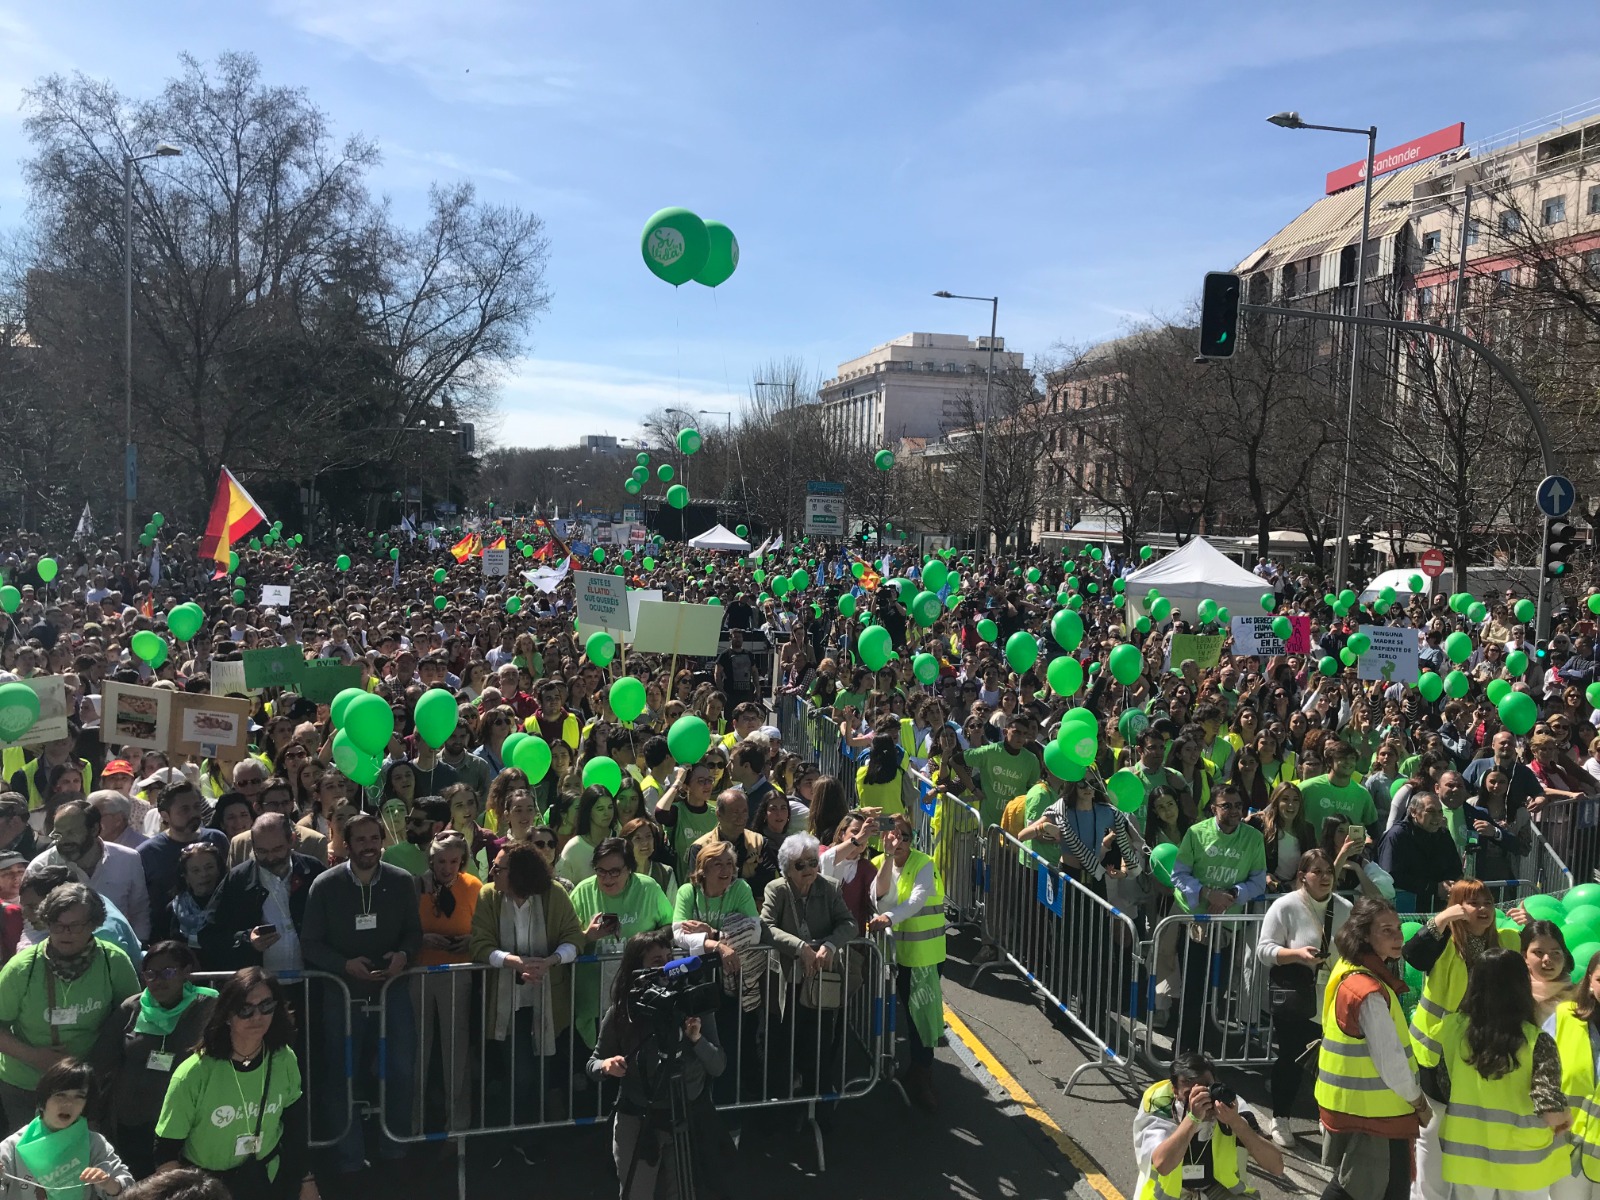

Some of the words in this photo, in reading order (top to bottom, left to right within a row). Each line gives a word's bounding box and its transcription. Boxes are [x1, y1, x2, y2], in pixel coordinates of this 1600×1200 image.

[1372, 146, 1421, 173] Santander
[654, 229, 674, 249] Sí
[651, 243, 682, 261] Vida!
[596, 596, 619, 606] QUERÉIS
[1254, 617, 1276, 625] DERECH
[1372, 630, 1403, 638] NINGUNA
[1261, 639, 1270, 647] EN
[1273, 638, 1282, 647] EL
[1370, 645, 1402, 653] RREPIENTE
[1205, 865, 1239, 884] ENJOY
[668, 967, 681, 977] AFP
[215, 1109, 234, 1125] Sí
[246, 1093, 283, 1119] Via!
